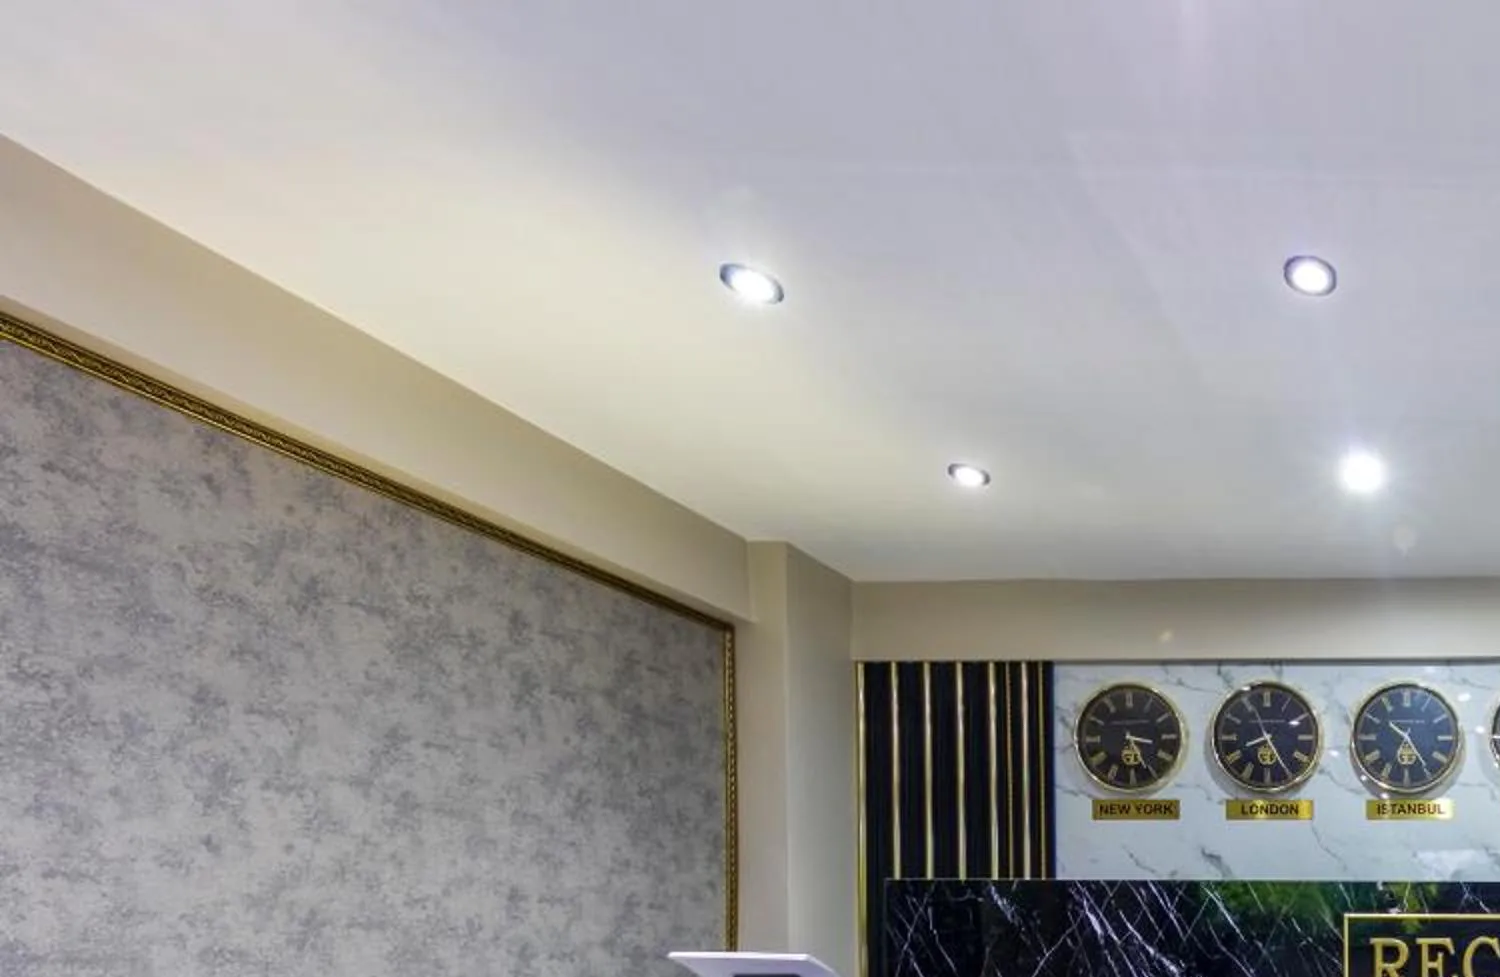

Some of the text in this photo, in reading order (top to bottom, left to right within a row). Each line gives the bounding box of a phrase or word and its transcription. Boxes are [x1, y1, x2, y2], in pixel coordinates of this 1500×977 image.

[1099, 803, 1174, 816] NEW YORK
[1241, 803, 1299, 815] LONDON
[1376, 803, 1446, 815] ISTANBUL
